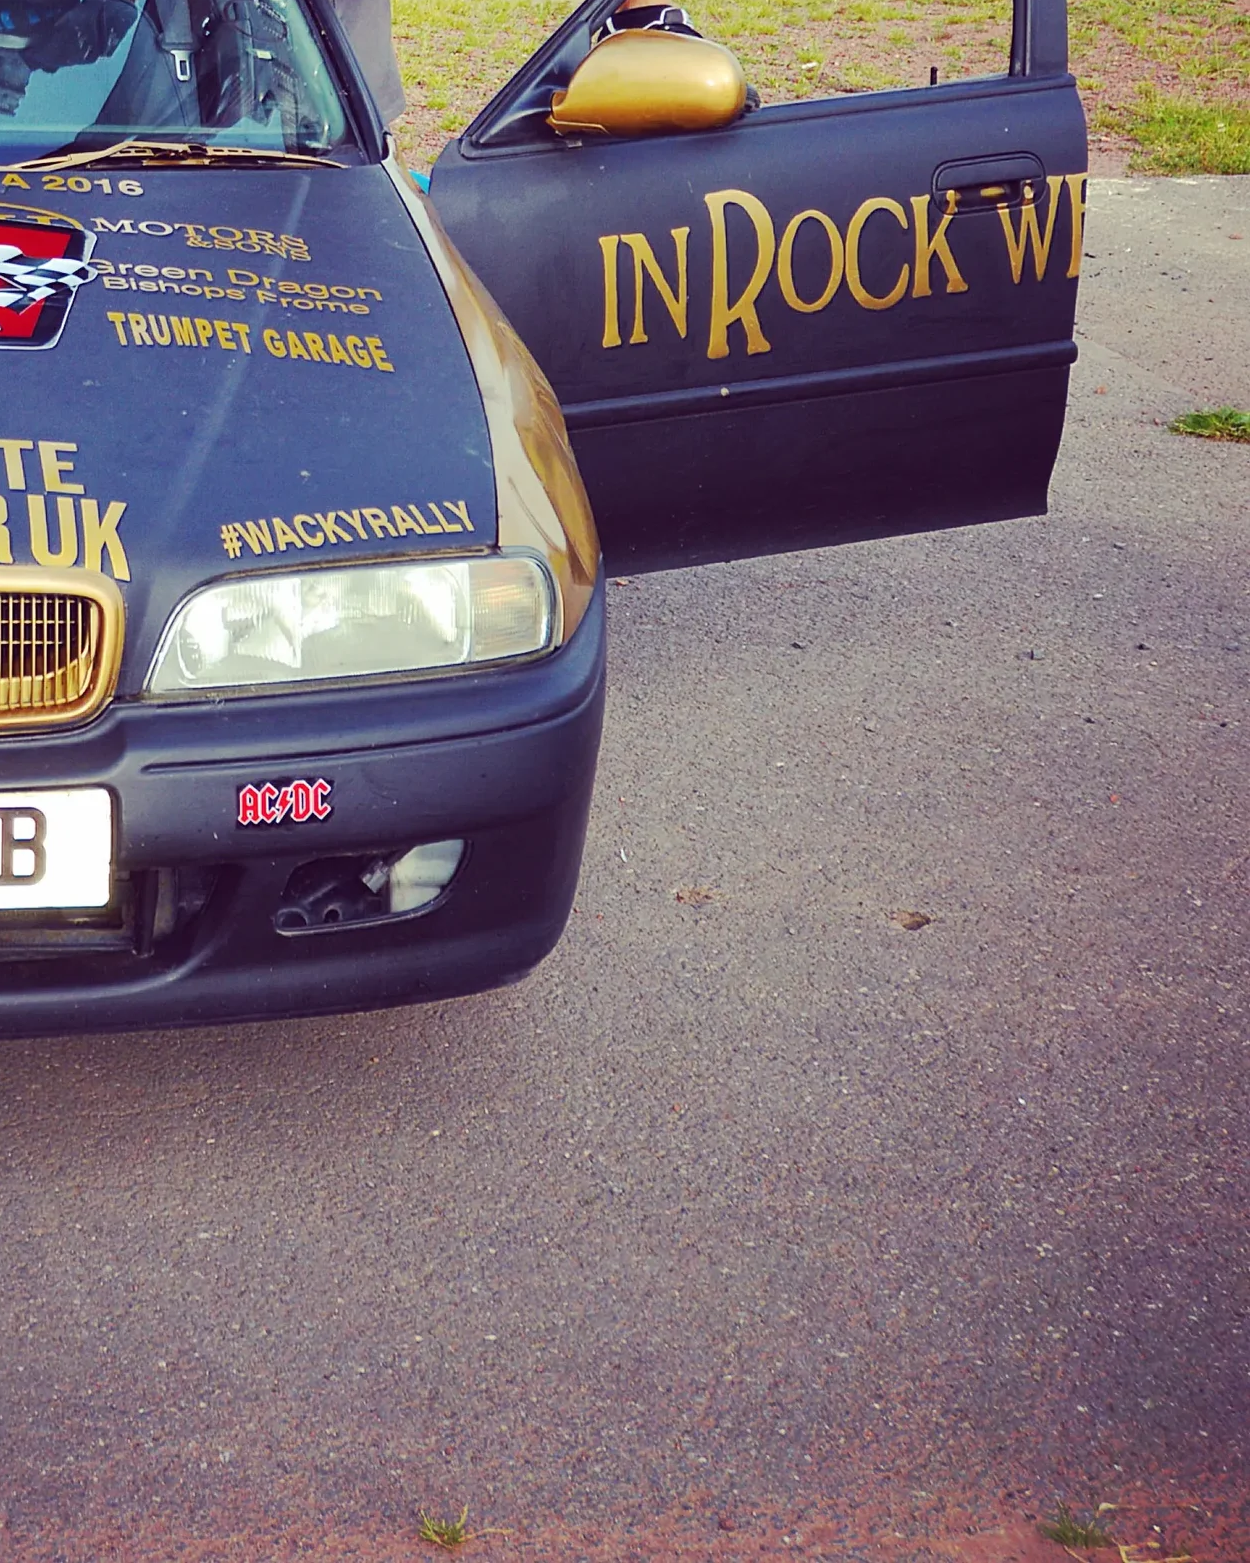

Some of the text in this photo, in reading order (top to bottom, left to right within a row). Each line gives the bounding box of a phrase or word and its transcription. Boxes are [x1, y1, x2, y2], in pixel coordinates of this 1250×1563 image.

[41, 175, 145, 197] 2016
[90, 217, 309, 250] MOTORS
[88, 259, 383, 302] Green Dragon
[102, 276, 370, 315] Bishops Frome
[107, 311, 395, 373] TRUMPET GARAGE
[27, 494, 131, 582] UK
[220, 500, 476, 559] #WACKYRALLY
